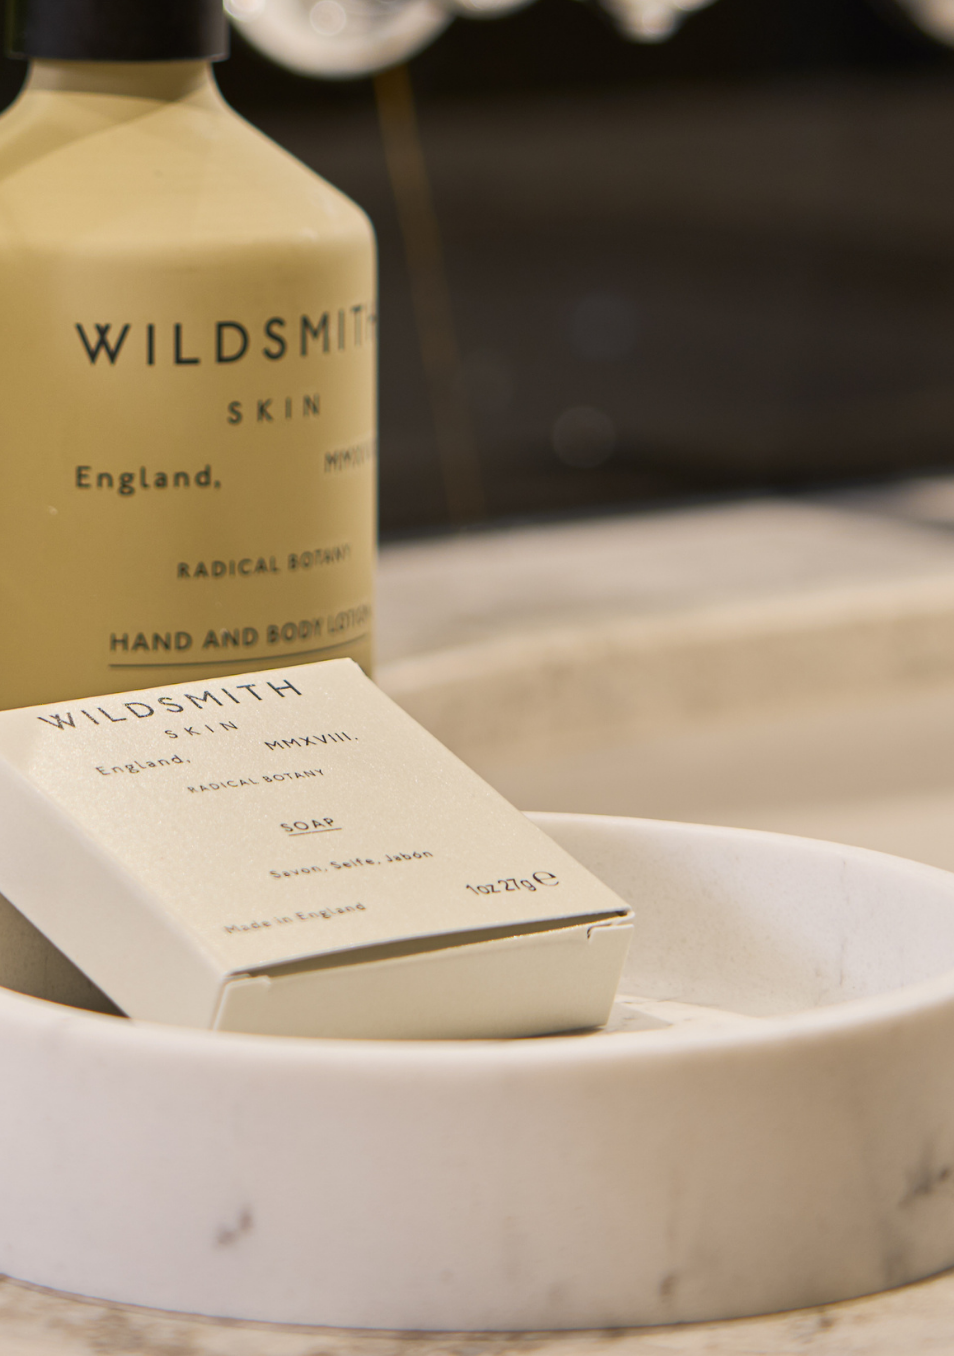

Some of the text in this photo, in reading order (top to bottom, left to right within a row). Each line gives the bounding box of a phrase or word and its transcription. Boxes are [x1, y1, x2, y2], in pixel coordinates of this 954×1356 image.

[227, 393, 322, 425] SKIN
[75, 464, 222, 496] England,
[177, 555, 280, 580] RADICAL
[109, 630, 194, 653] HAND
[201, 626, 260, 650] AND
[266, 616, 323, 645] BODY
[36, 678, 303, 731] WILDSMITH
[164, 720, 239, 740] SKIN
[95, 731, 359, 777] England, MMXVIII.
[187, 768, 325, 794] RADICAL BOTANY
[280, 816, 335, 833] SOAP
[223, 902, 367, 935] Made in England
